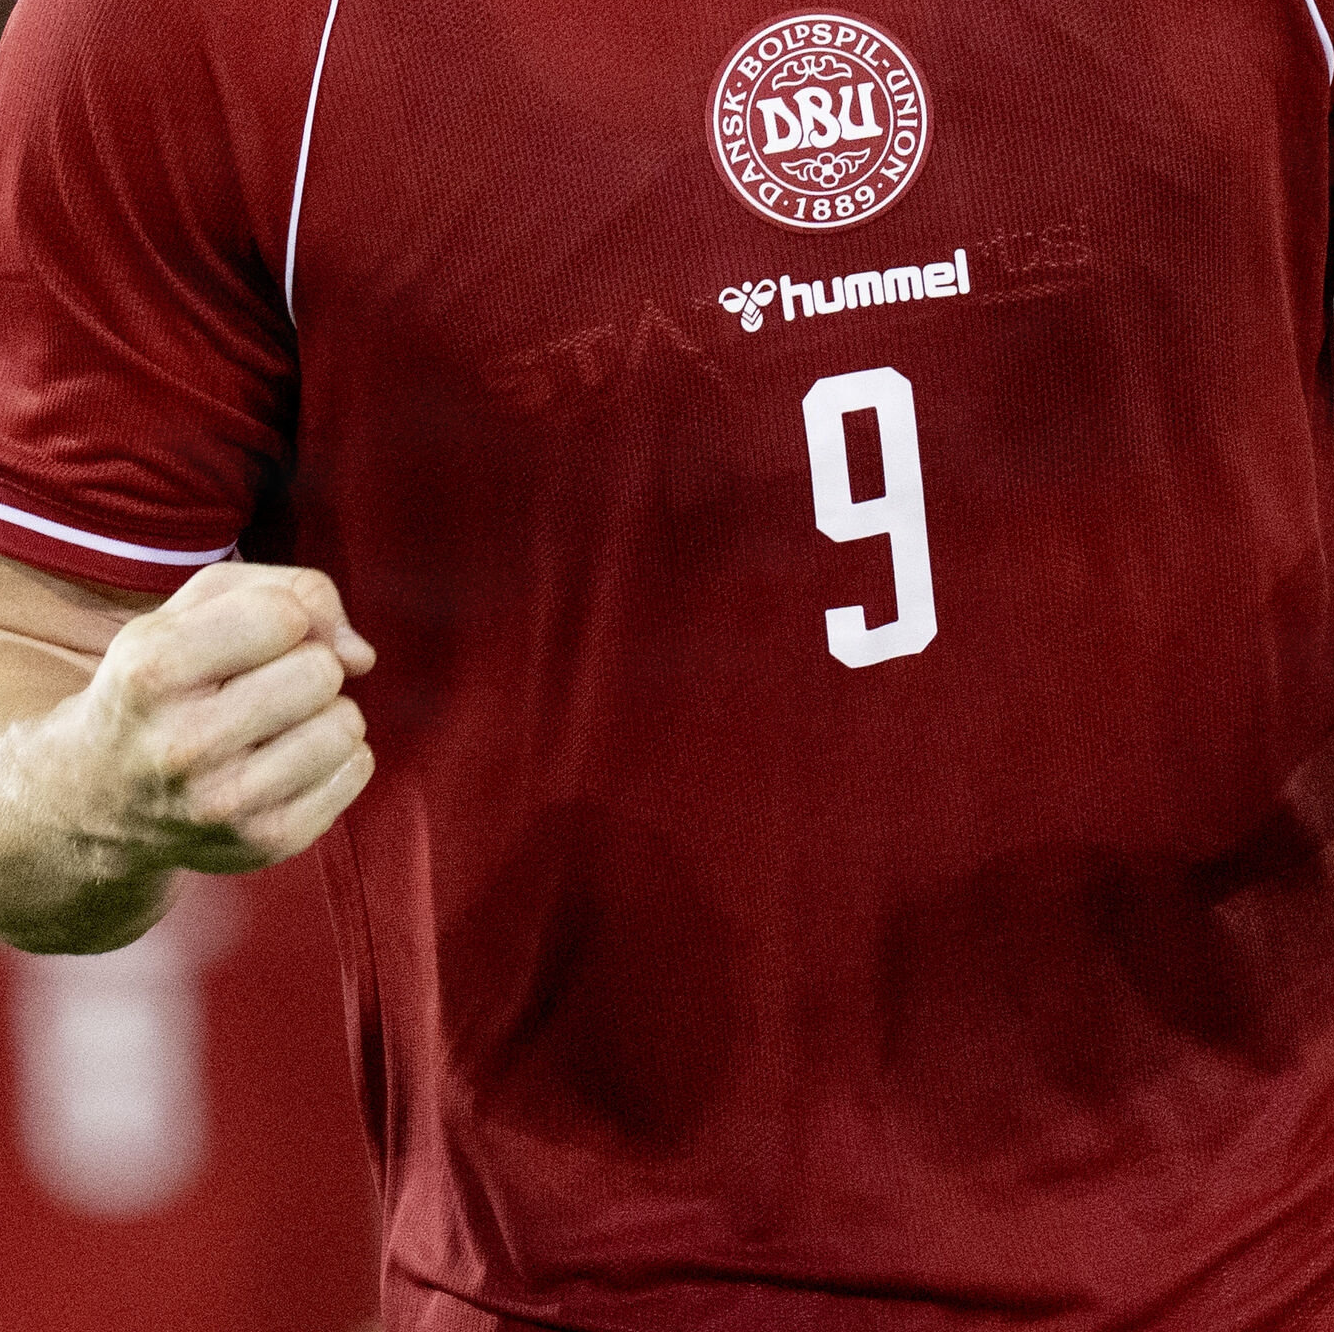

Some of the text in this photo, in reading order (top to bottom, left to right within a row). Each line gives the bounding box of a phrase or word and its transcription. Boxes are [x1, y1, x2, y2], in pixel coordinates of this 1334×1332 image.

[722, 89, 783, 207] DANSK
[755, 82, 883, 155] DBU
[793, 185, 876, 221] 1889
[779, 248, 971, 321] hummel
[801, 366, 938, 668] 9
